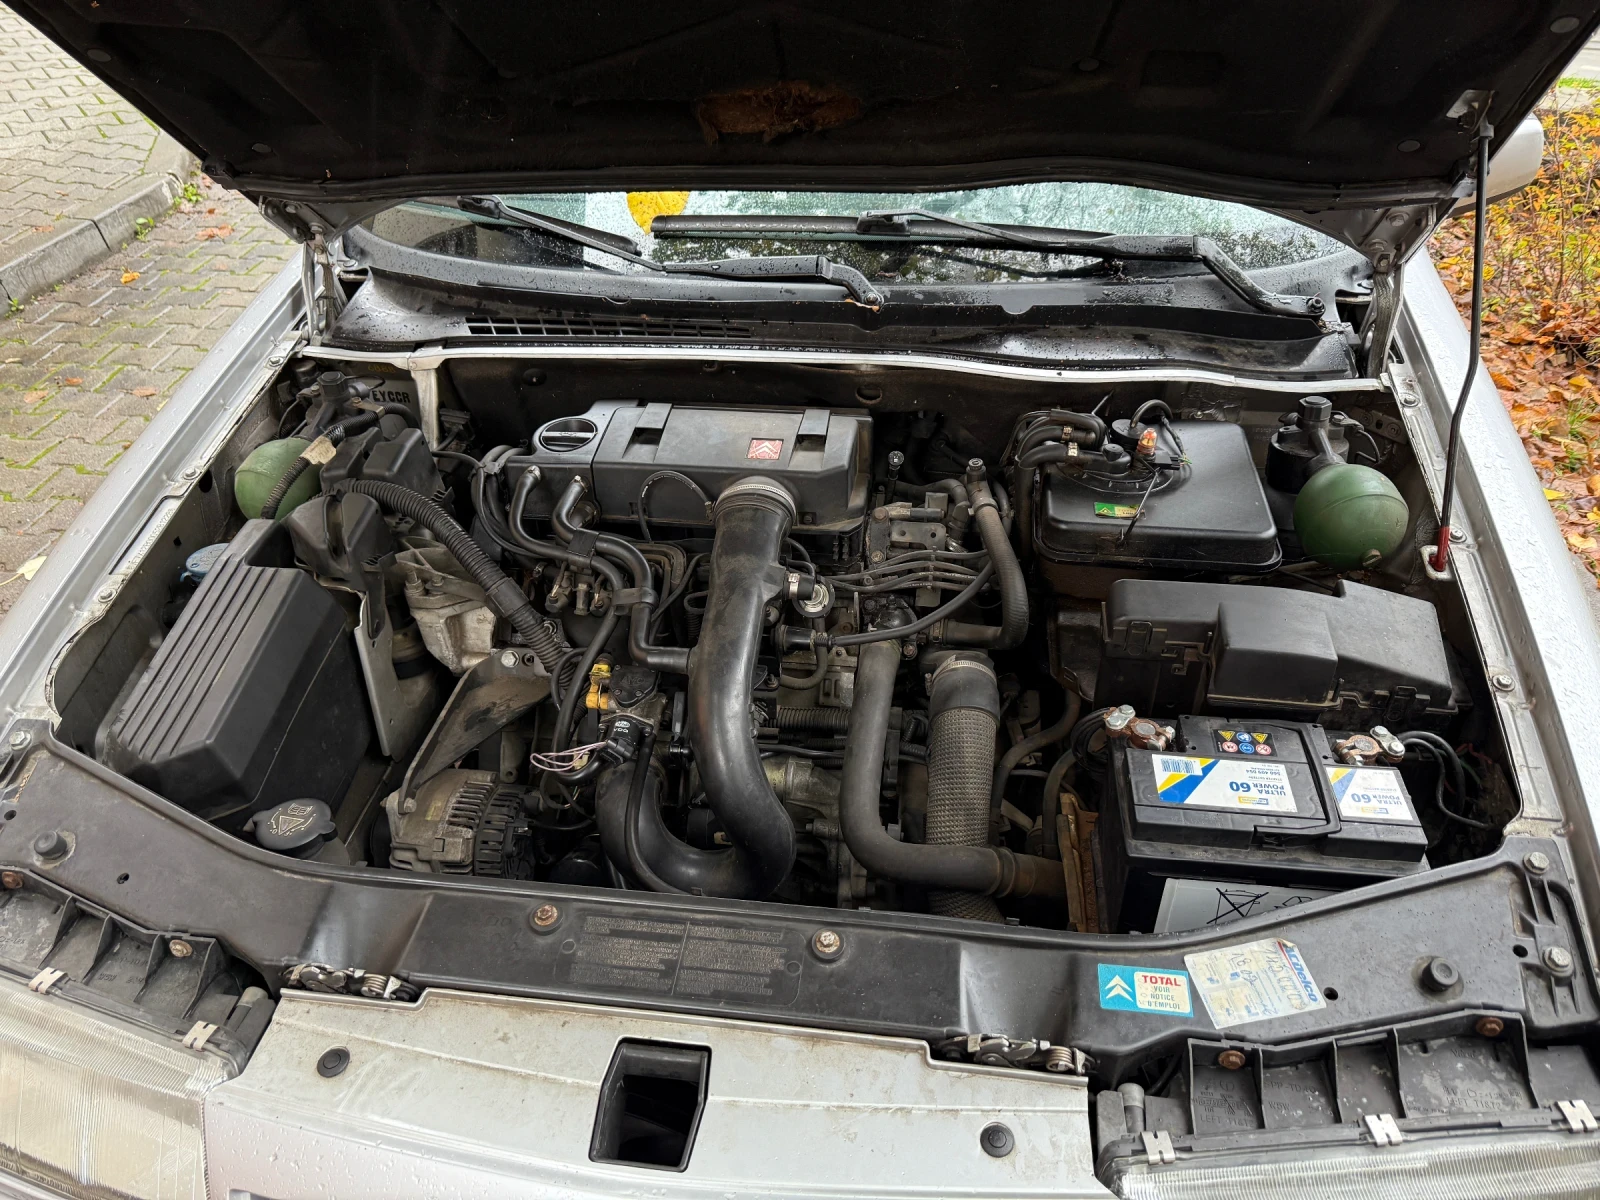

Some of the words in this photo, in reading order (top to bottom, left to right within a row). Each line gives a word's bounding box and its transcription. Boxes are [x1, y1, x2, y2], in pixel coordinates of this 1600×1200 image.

[1229, 781, 1251, 793] 60
[1252, 782, 1285, 790] POWER
[1257, 788, 1286, 796] ULTRA
[1351, 793, 1371, 803] 60
[1142, 975, 1181, 987] TOTAL
[1151, 993, 1175, 1001] NOTICE
[1148, 1000, 1180, 1009] D'EMPLOI
